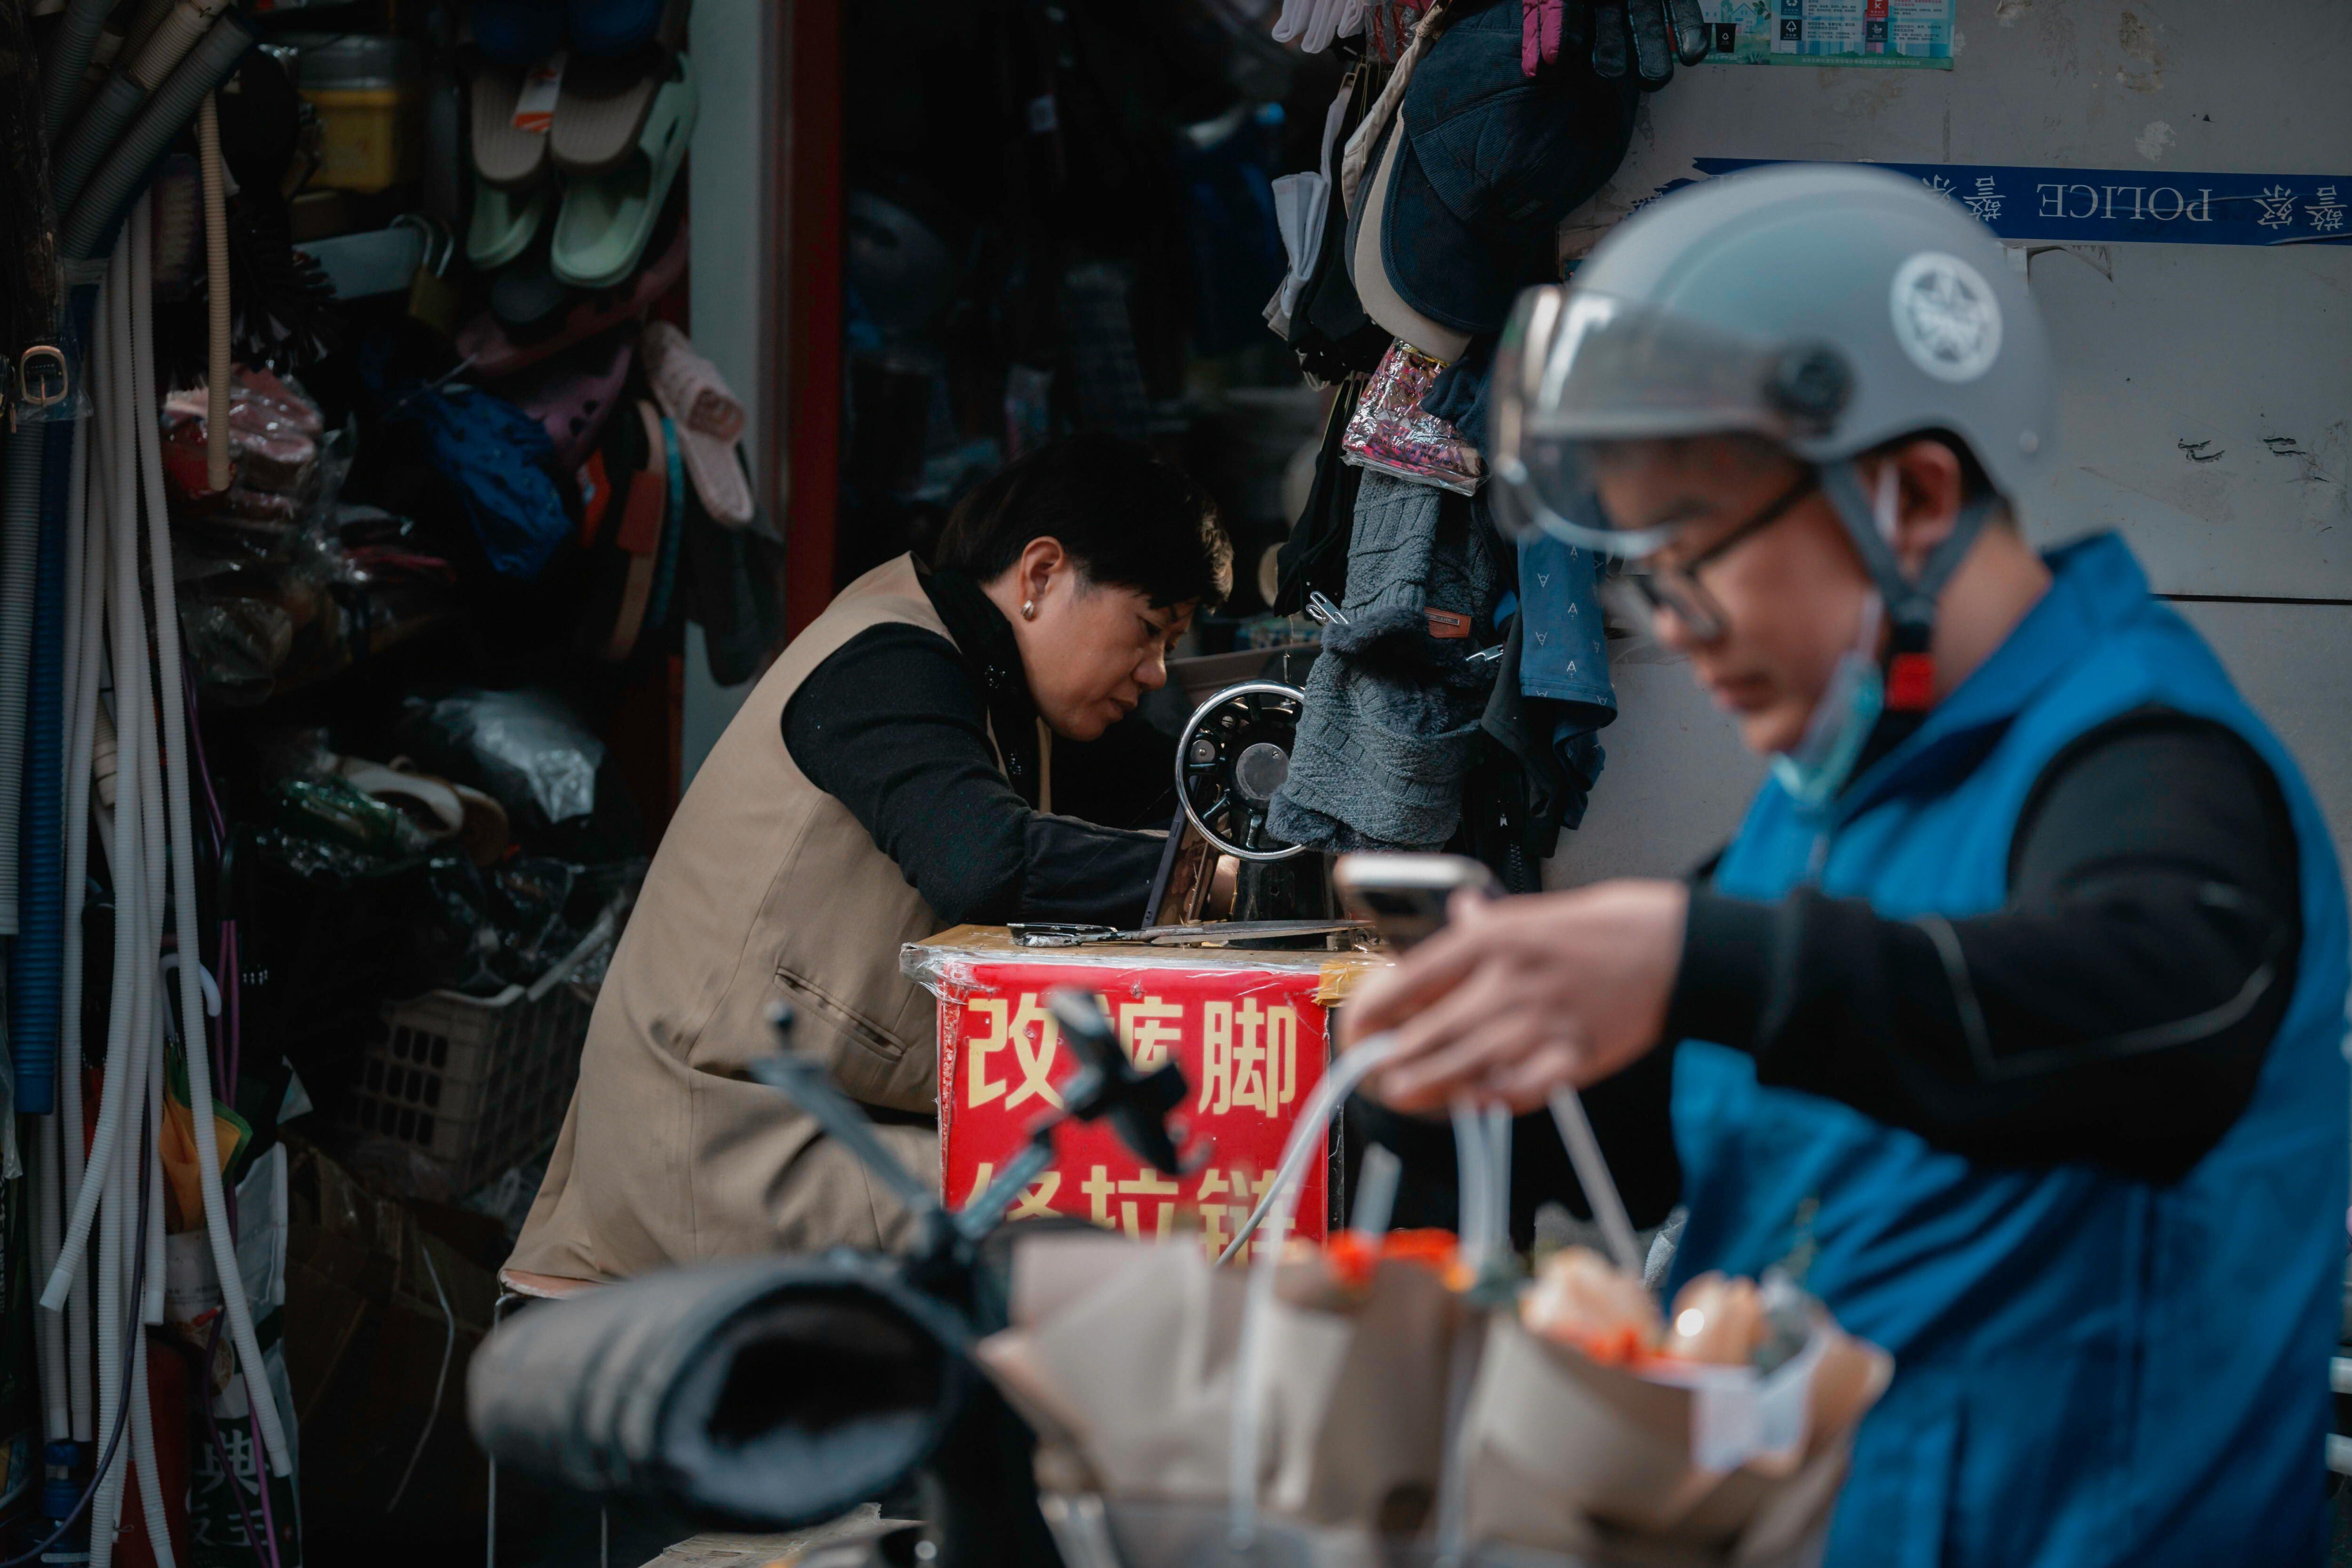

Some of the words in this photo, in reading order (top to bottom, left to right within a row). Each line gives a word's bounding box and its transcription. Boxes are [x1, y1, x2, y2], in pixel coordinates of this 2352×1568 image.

[2035, 183, 2213, 223] POLICE
[2252, 183, 2349, 231] 警察
[1419, 451, 1453, 467] ORIGINAL
